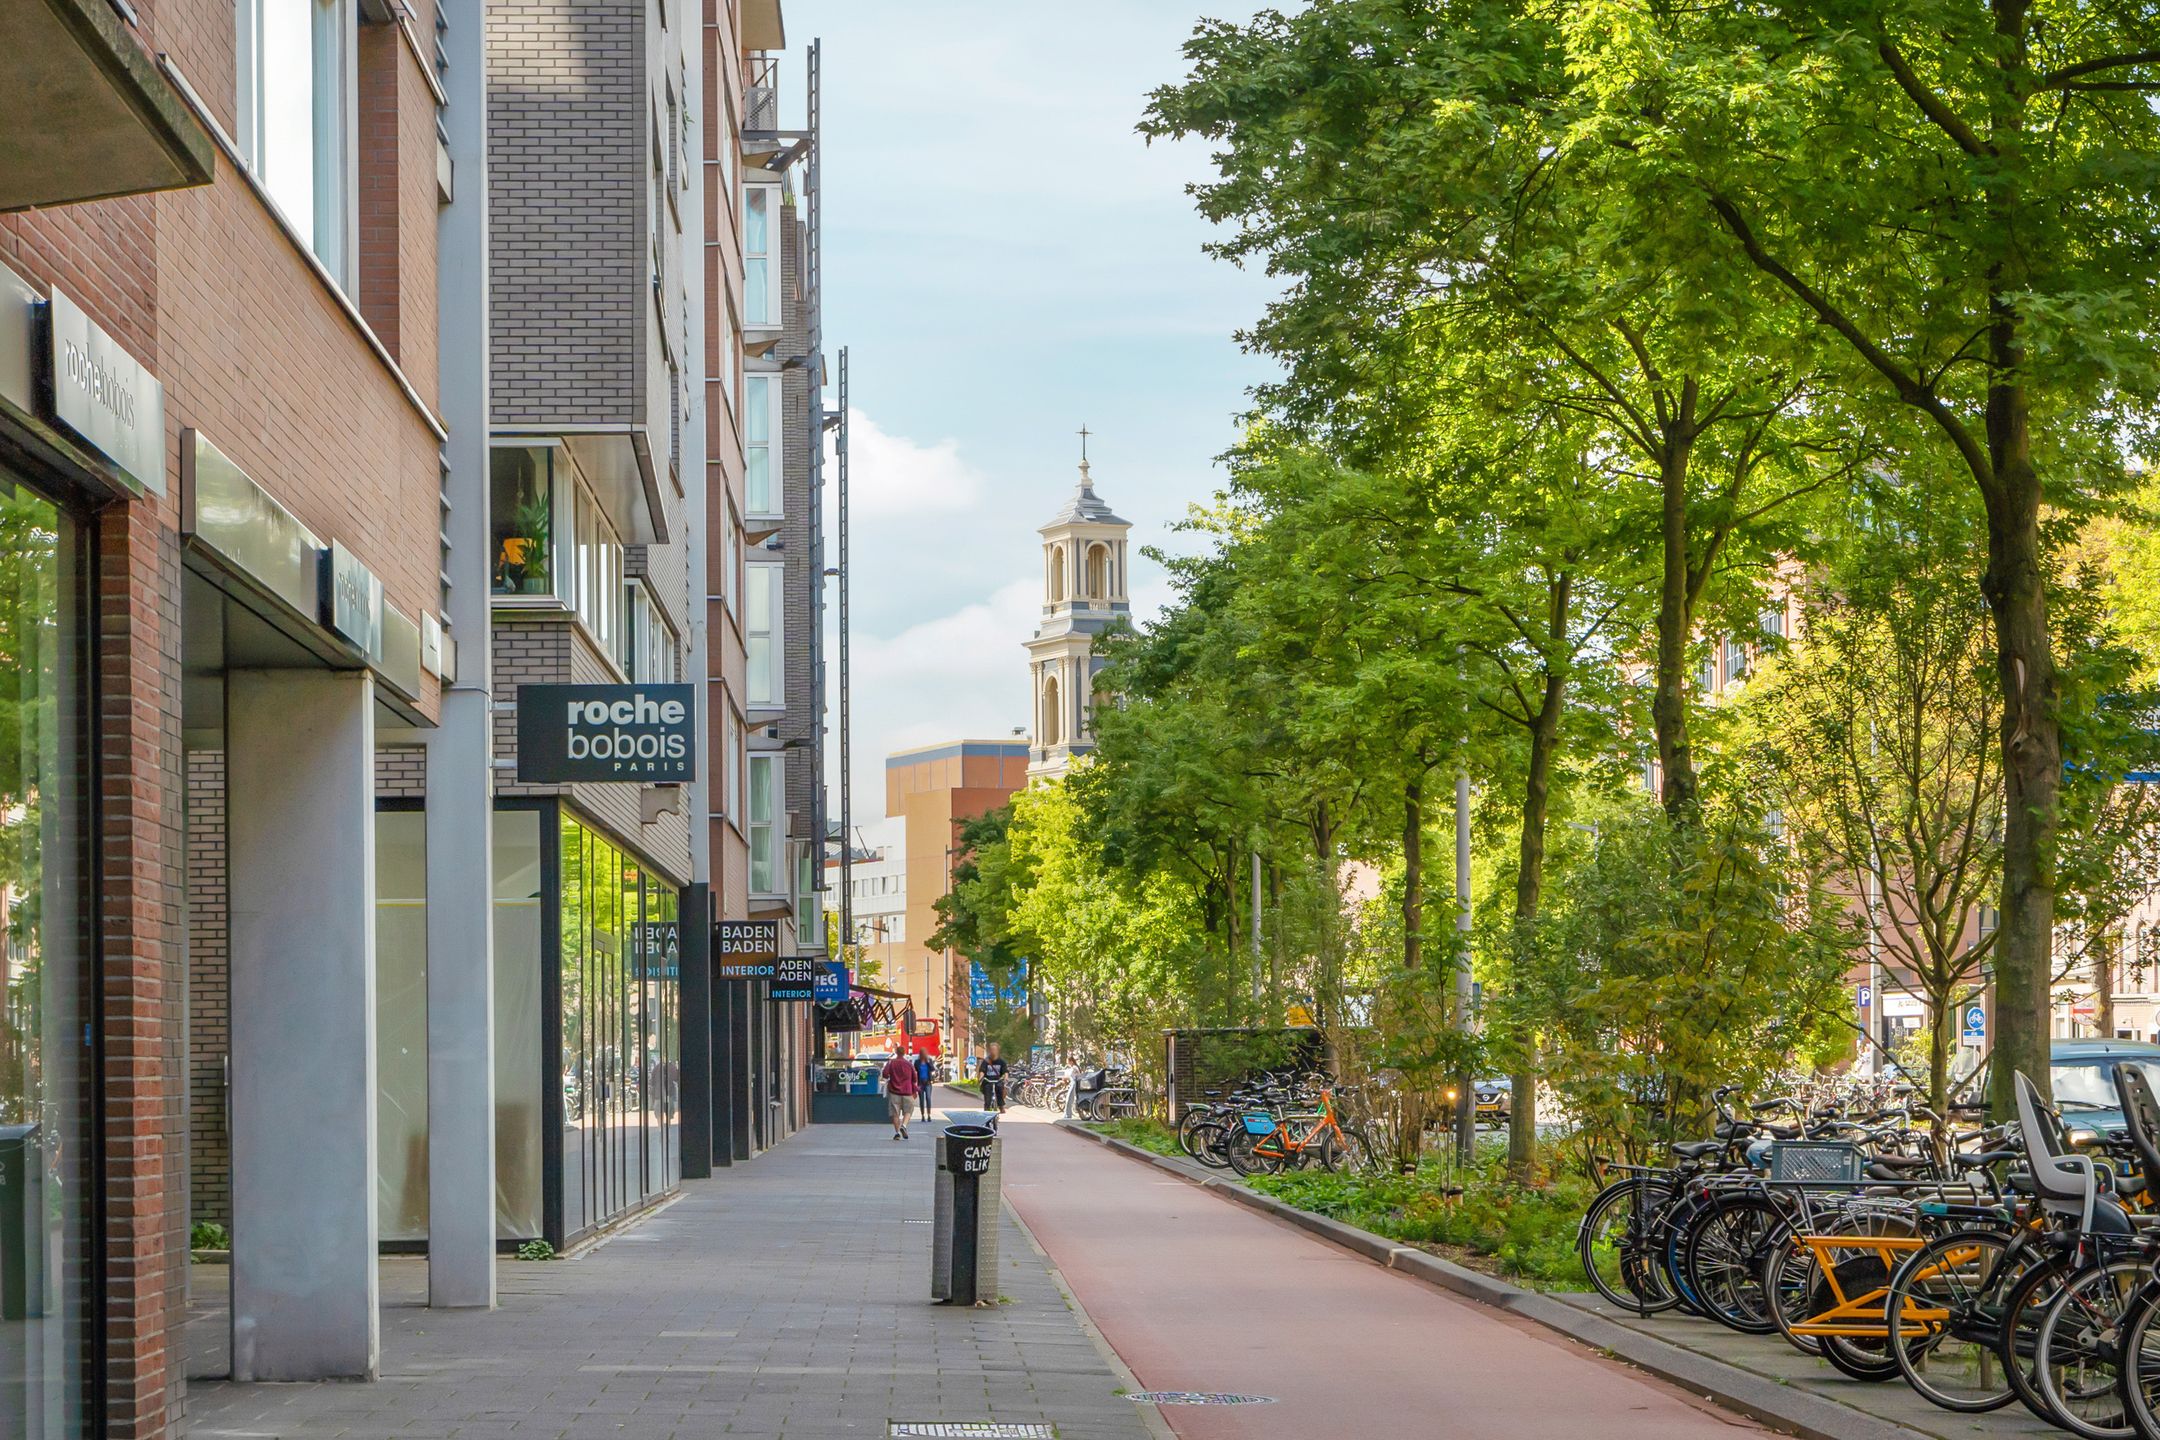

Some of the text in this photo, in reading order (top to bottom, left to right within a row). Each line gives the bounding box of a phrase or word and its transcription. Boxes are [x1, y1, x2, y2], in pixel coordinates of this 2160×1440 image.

[567, 693, 685, 725] roche
[567, 726, 686, 760] bobois
[614, 762, 685, 771] PARIS
[722, 926, 775, 938] BADEN
[722, 940, 775, 953] BADEN
[722, 965, 775, 976] INTERIOR
[779, 960, 812, 970] ADEN
[779, 971, 812, 981] ADEN
[772, 990, 812, 998] INTERIOR
